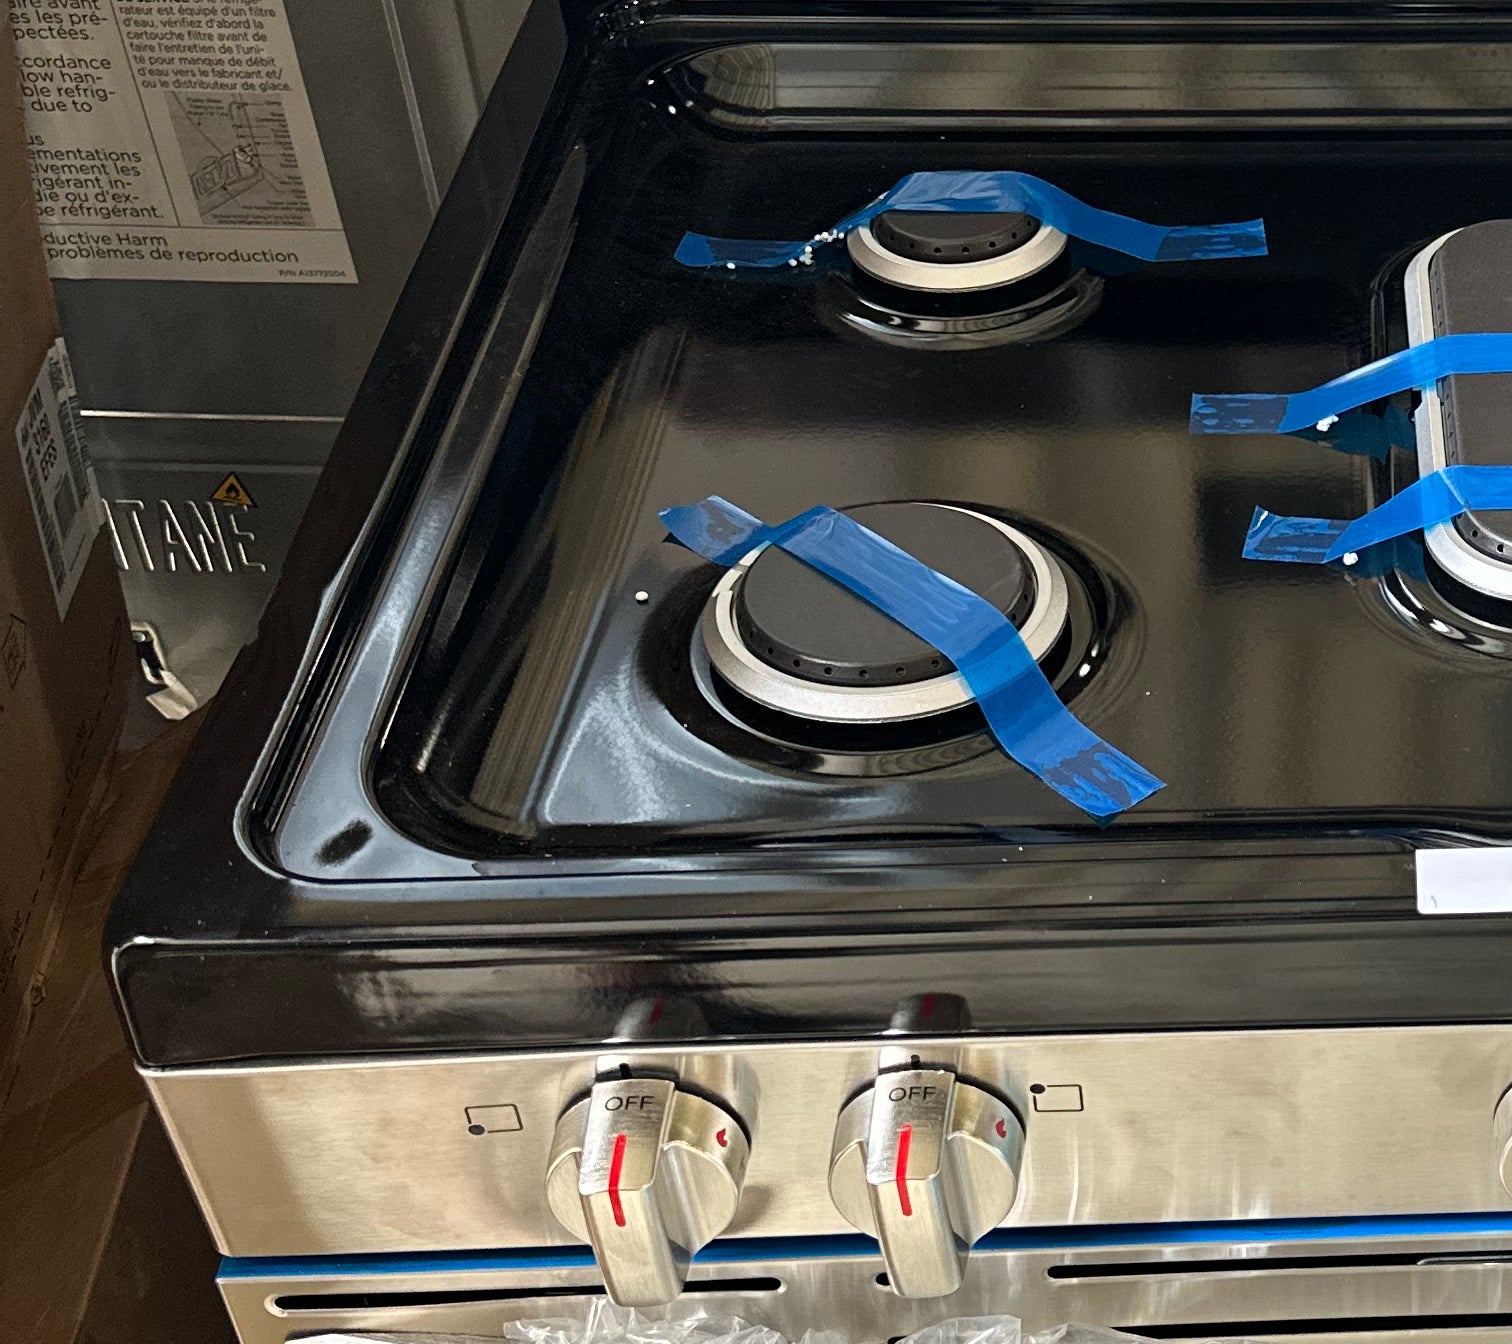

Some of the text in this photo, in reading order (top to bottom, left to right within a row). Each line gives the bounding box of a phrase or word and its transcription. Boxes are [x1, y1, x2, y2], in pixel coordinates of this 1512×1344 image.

[36, 10, 63, 24] les
[69, 11, 108, 26] pré-
[126, 30, 185, 41] cartouche
[217, 32, 250, 42] avant
[61, 70, 103, 84] han-
[57, 84, 116, 102] refrig-
[31, 99, 93, 112] due to
[114, 163, 141, 177] les
[108, 176, 132, 189] in-
[64, 190, 140, 204] ou d'ex-
[116, 232, 169, 247] Harm
[48, 246, 299, 264] problèmes de reproduction
[888, 1085, 936, 1103] OFF
[605, 1094, 655, 1112] OFF
